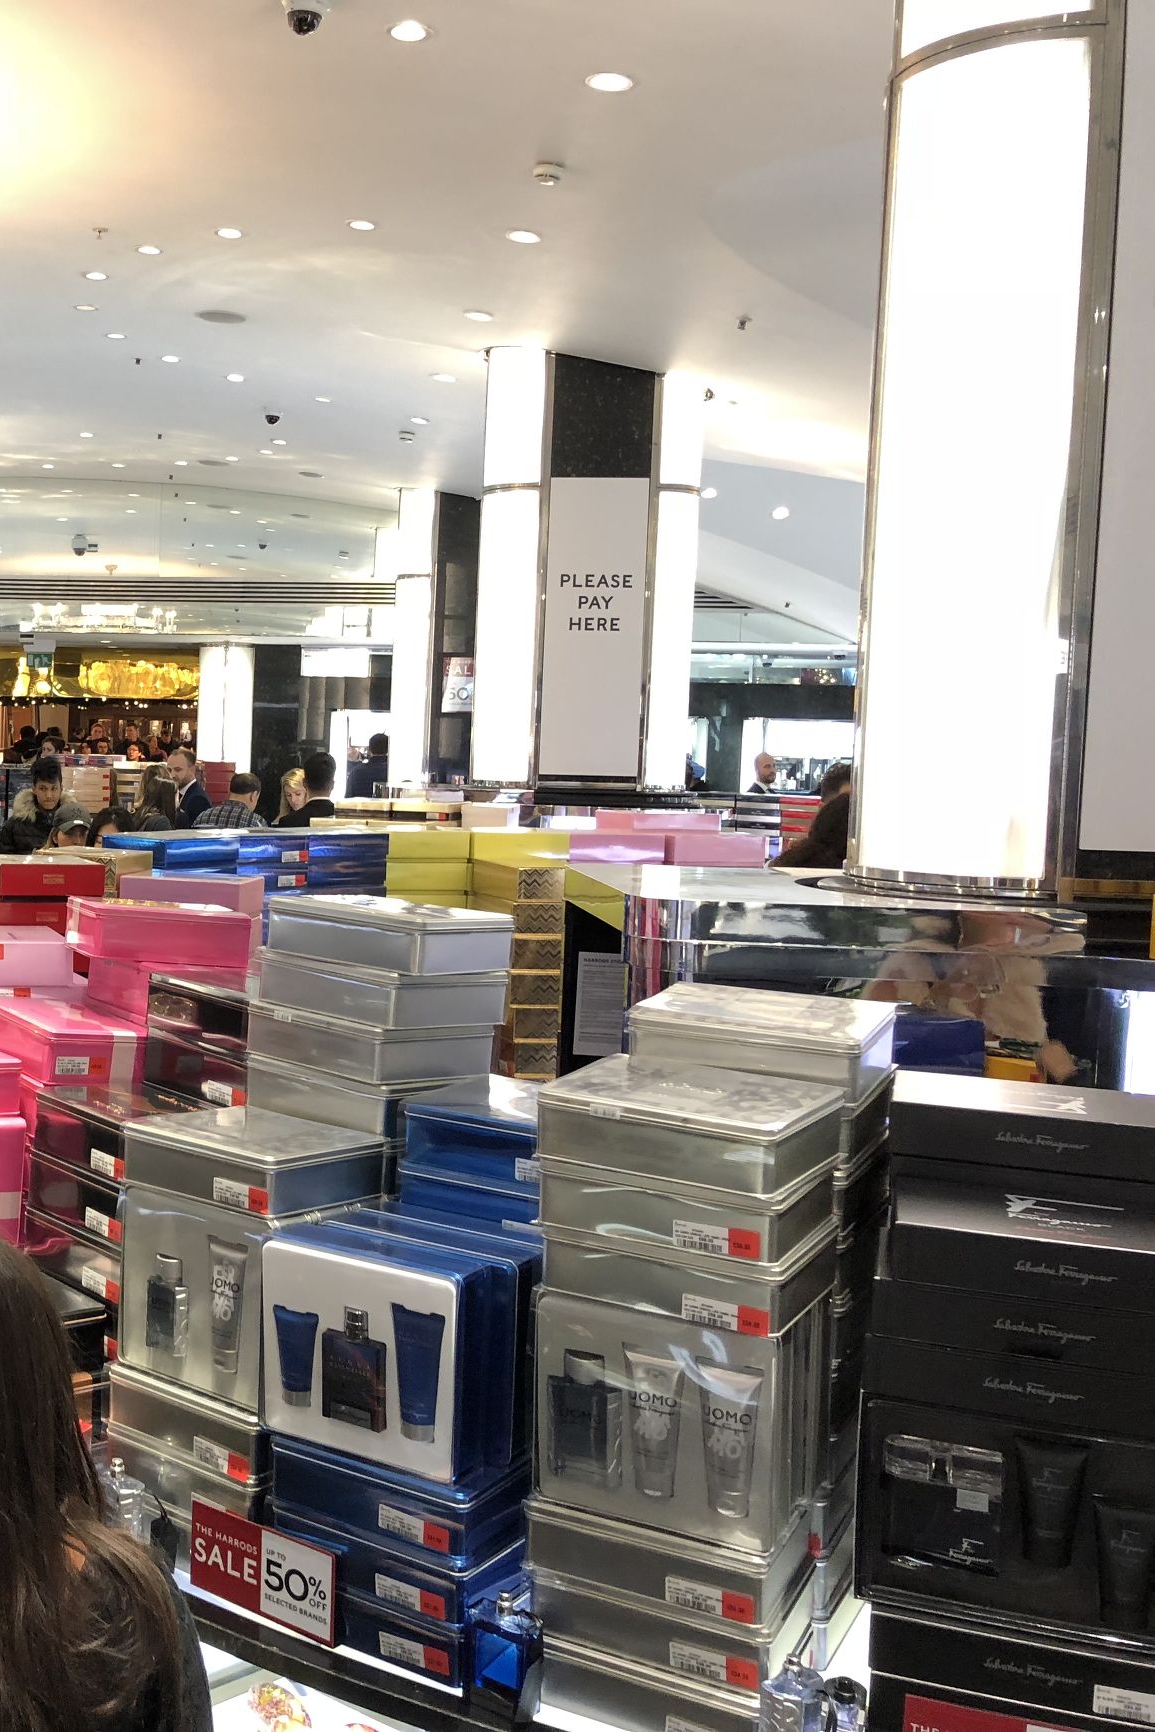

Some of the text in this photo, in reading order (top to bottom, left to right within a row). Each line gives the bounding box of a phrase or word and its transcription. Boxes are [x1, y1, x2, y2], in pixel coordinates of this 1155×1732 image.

[560, 574, 633, 588] PLEASE
[578, 595, 614, 610] PAY
[569, 617, 620, 631] HERE
[703, 1406, 753, 1426] UOMO
[195, 1522, 258, 1555] THE HARRODS
[194, 1537, 258, 1585] SALE
[266, 1548, 286, 1561] UP TO
[264, 1558, 326, 1602] 50%
[264, 1593, 327, 1625] SELECTED BRANDS
[309, 1598, 327, 1612] OFF
